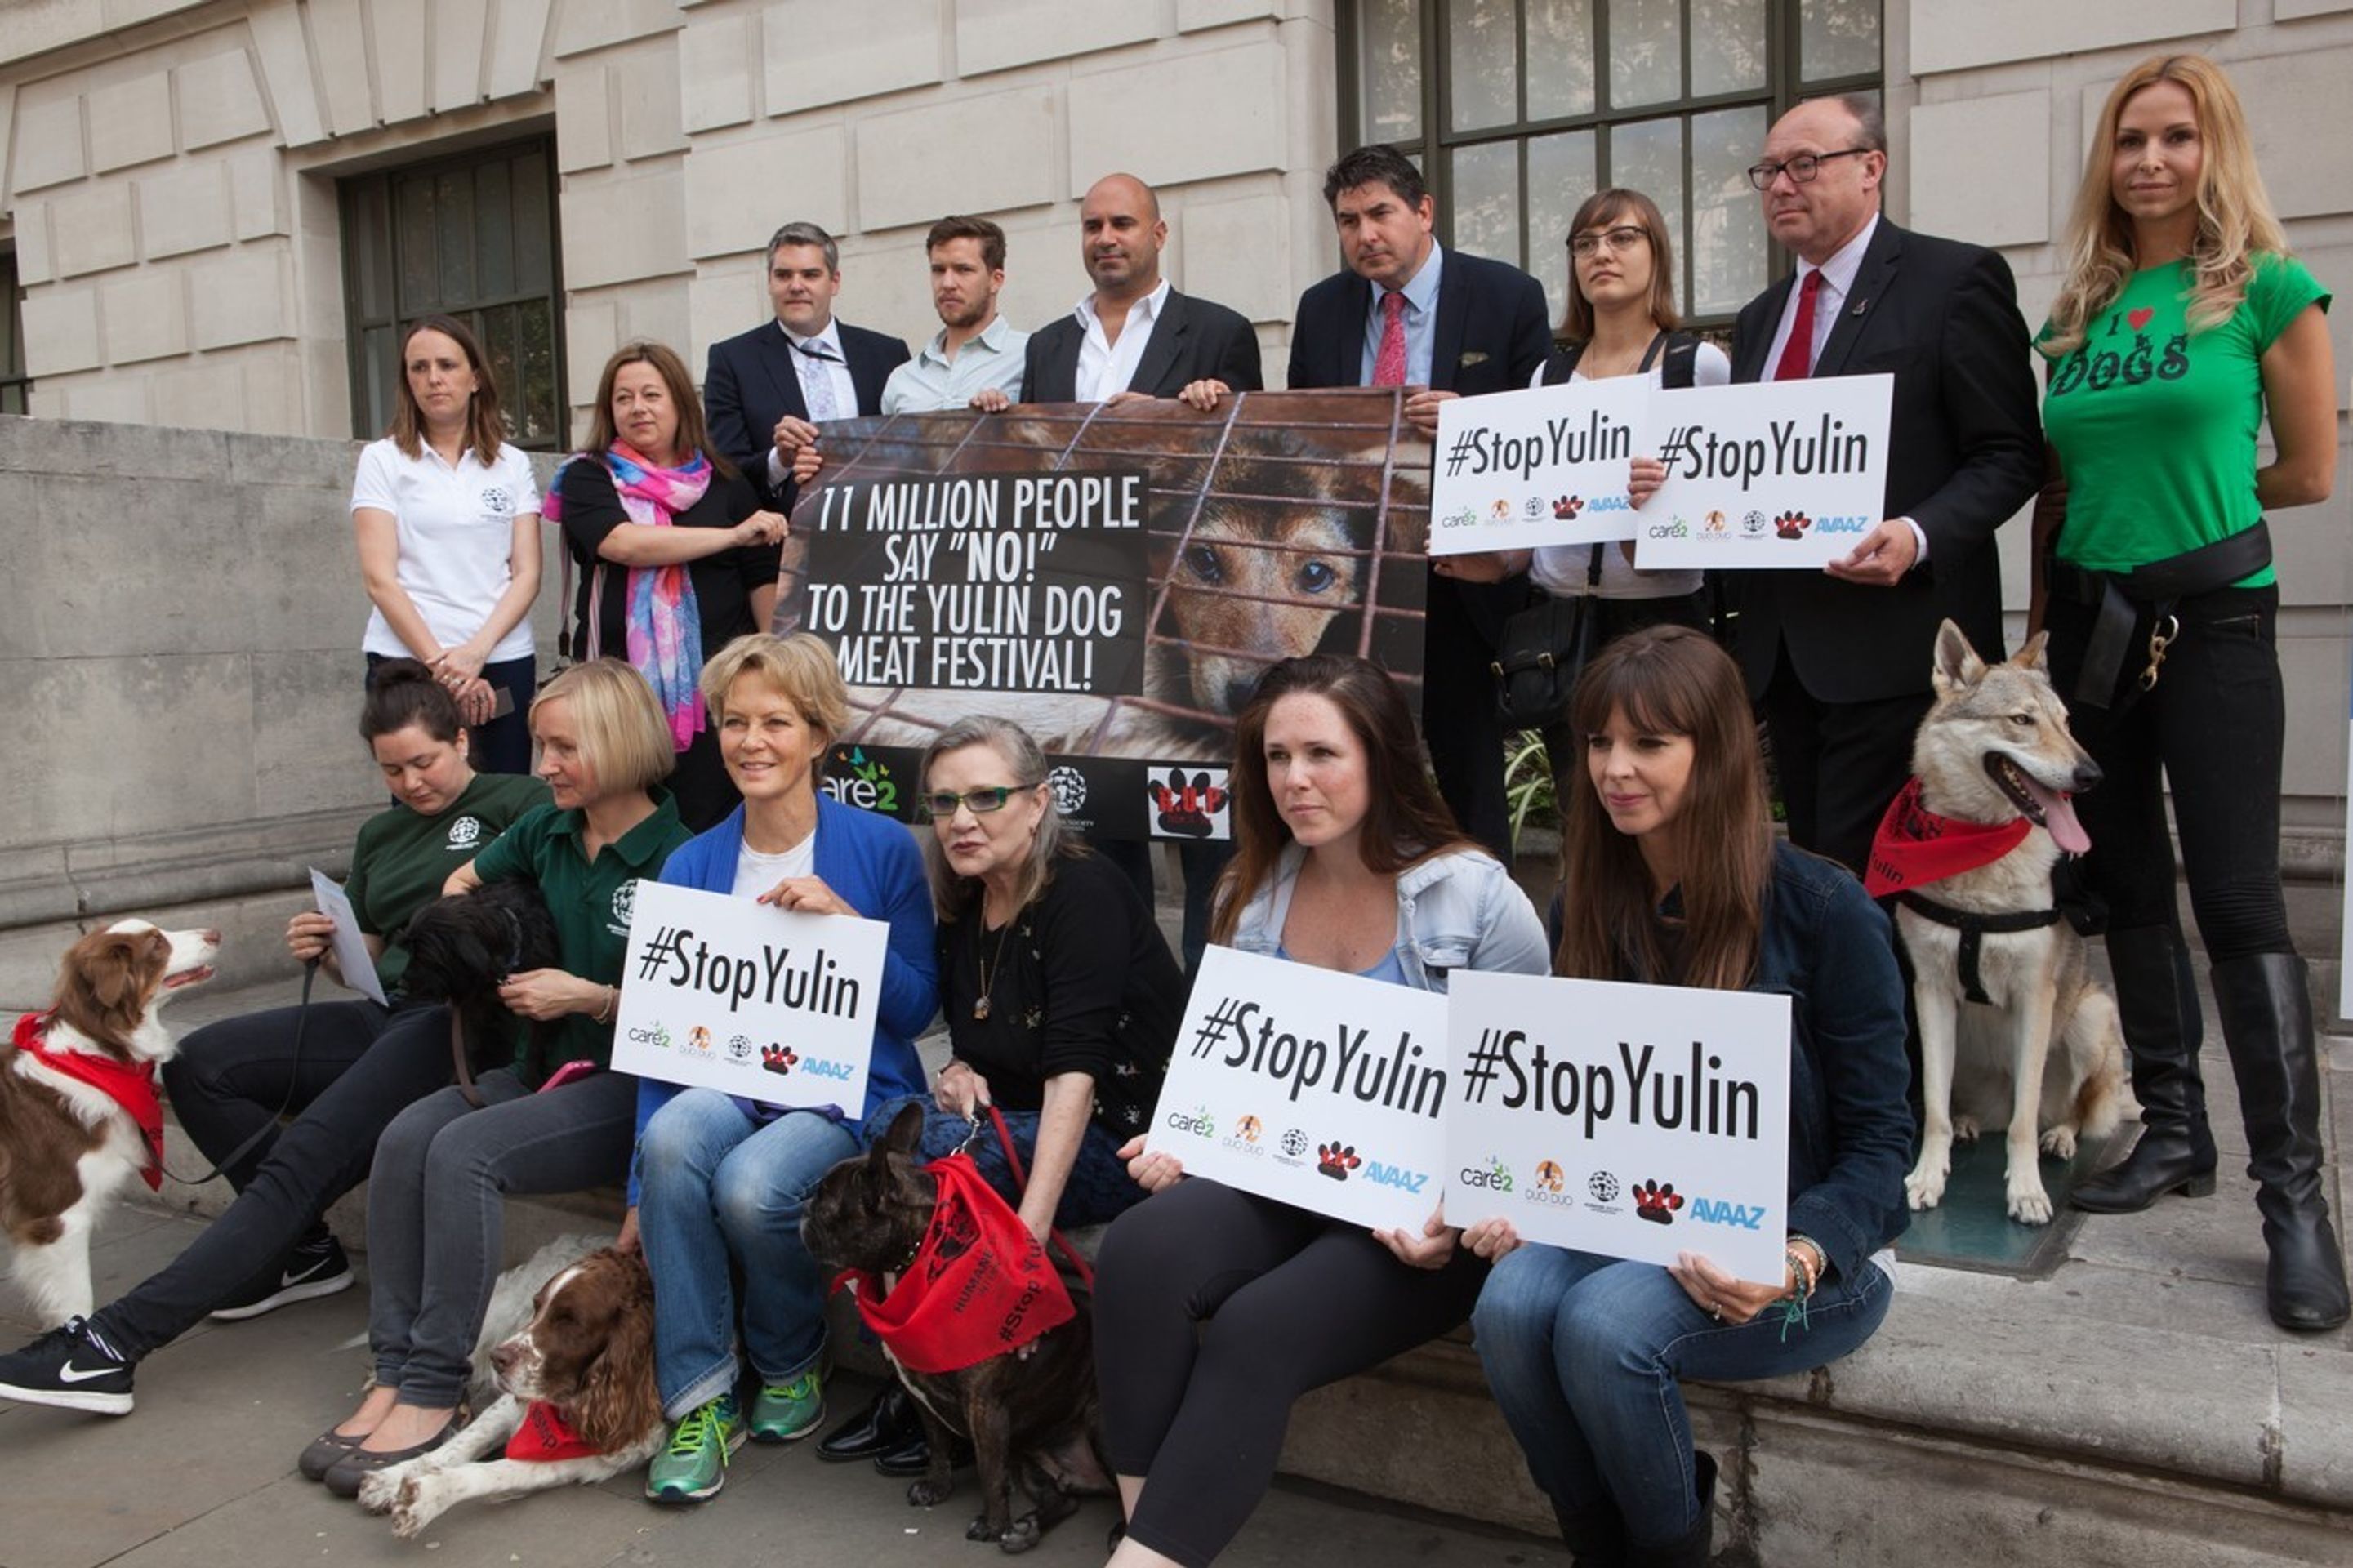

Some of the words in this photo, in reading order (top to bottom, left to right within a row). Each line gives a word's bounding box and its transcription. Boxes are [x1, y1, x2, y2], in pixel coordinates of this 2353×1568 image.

[2107, 312, 2122, 336] I
[2050, 333, 2190, 397] DOGS
[1446, 410, 1630, 480] #StopYulin
[1660, 413, 1867, 491] #StopYulin
[819, 486, 853, 531] 11
[867, 479, 999, 532] MILLION
[1014, 476, 1140, 529] PEOPLE
[1442, 513, 1477, 529] care2
[1649, 523, 1687, 539] care2
[1815, 515, 1868, 533] AVAAZ
[884, 534, 938, 582] SAY
[808, 584, 849, 631] TO
[860, 585, 916, 633] THE
[926, 585, 1030, 635] YULIN
[1045, 586, 1122, 638] DOG
[836, 636, 920, 685] MEAT
[932, 637, 1094, 690] FESTIVAL!
[821, 776, 898, 811] are2
[640, 926, 859, 1019] #StopYulin
[629, 1027, 671, 1048] care2
[800, 1057, 855, 1082] AVAAZ
[1191, 997, 1447, 1119] #StopYulin
[1463, 1027, 1759, 1140] #StopYulin
[1168, 1111, 1214, 1138] care2
[1362, 1160, 1429, 1194] AVAAZ
[1460, 1168, 1513, 1193] care2
[1689, 1197, 1766, 1231] AVAAZ
